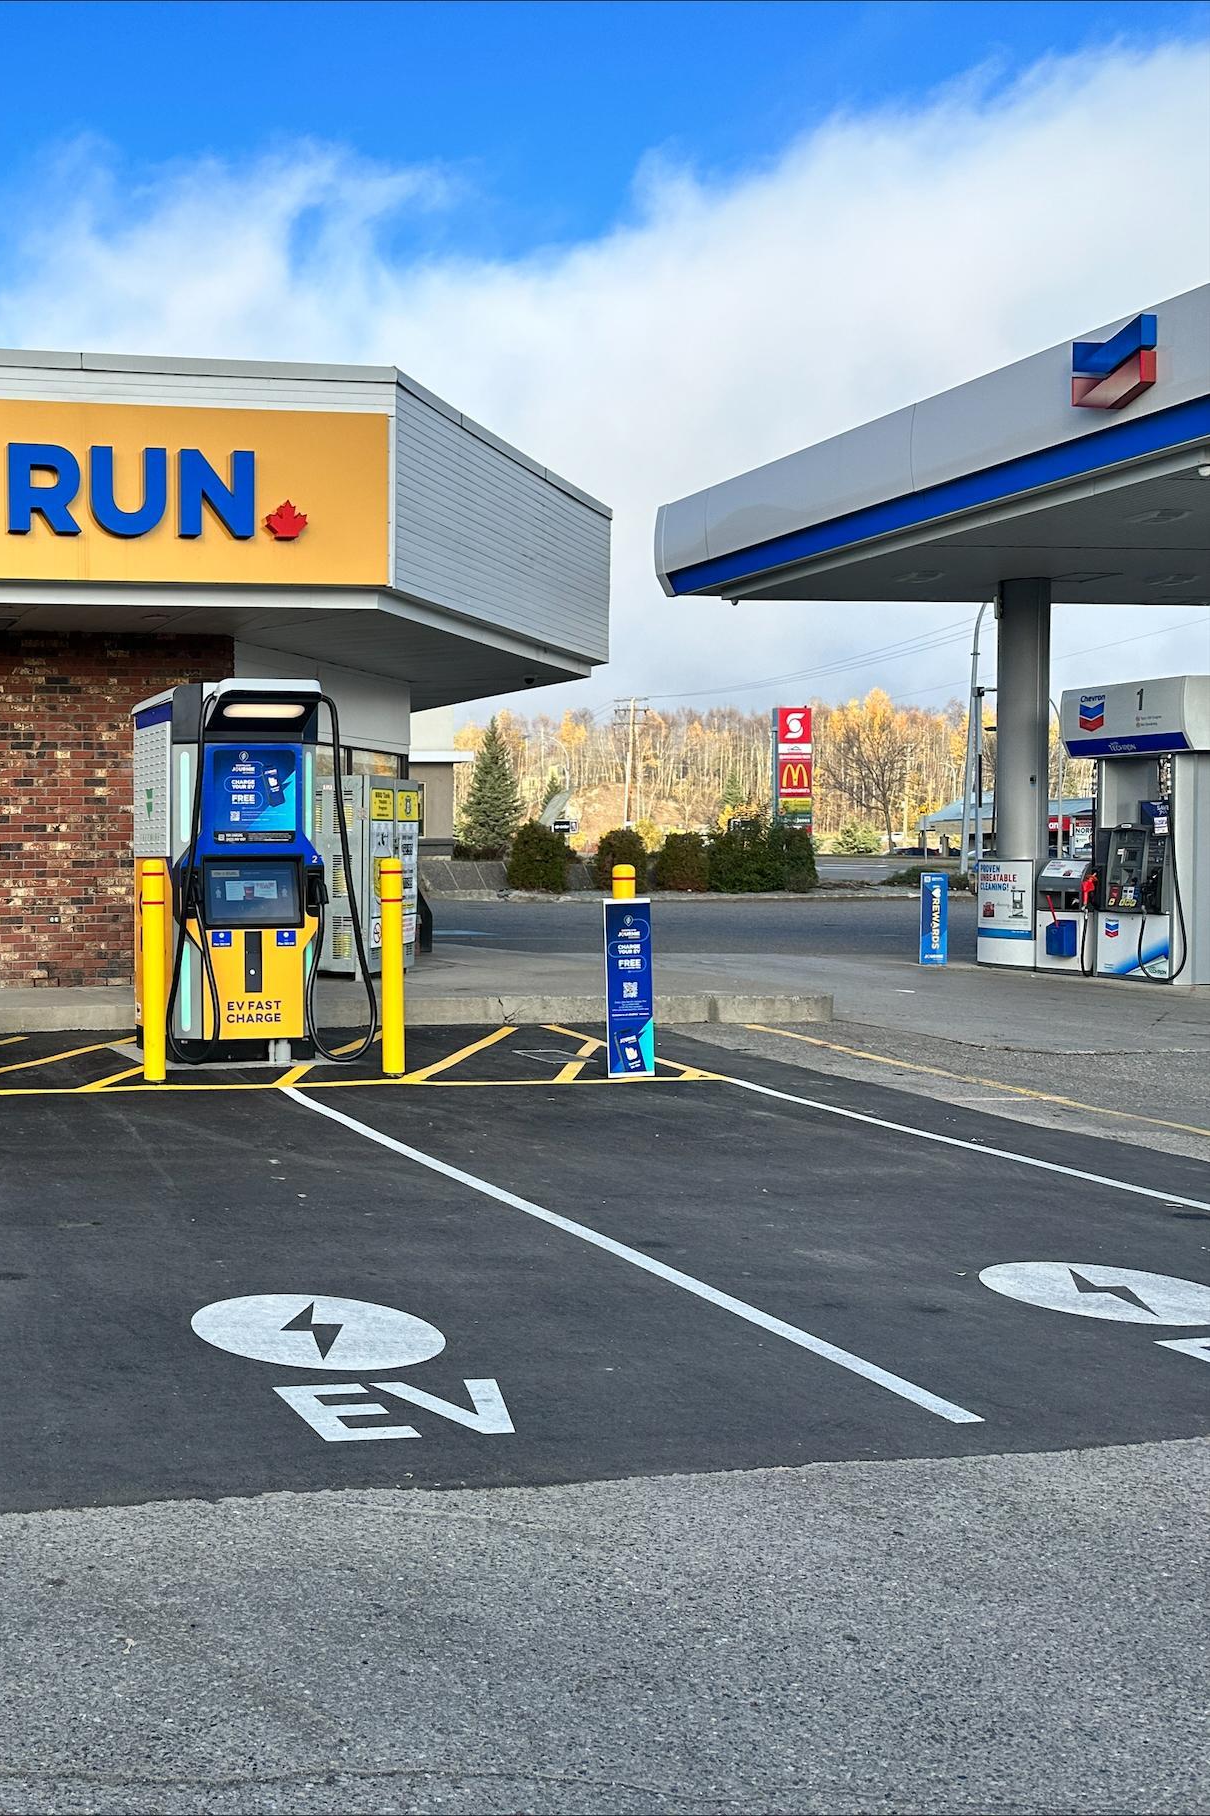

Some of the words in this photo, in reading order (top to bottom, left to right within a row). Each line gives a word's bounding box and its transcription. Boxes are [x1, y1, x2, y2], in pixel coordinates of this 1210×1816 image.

[7, 443, 256, 539] RUN
[1080, 694, 1106, 703] Chevron
[1136, 688, 1144, 711] 1
[231, 794, 256, 802] FREE
[311, 855, 318, 864] 2
[980, 864, 1001, 873] PROVEN
[980, 873, 1018, 883] UNBEATABLE
[980, 882, 1009, 892] CLEANING!
[931, 897, 941, 950] REWARDS
[618, 959, 642, 967] FREE
[227, 1001, 245, 1011] EV
[248, 1000, 282, 1011] FAST
[226, 1013, 282, 1024] CHARGE
[271, 1378, 516, 1442] EV
